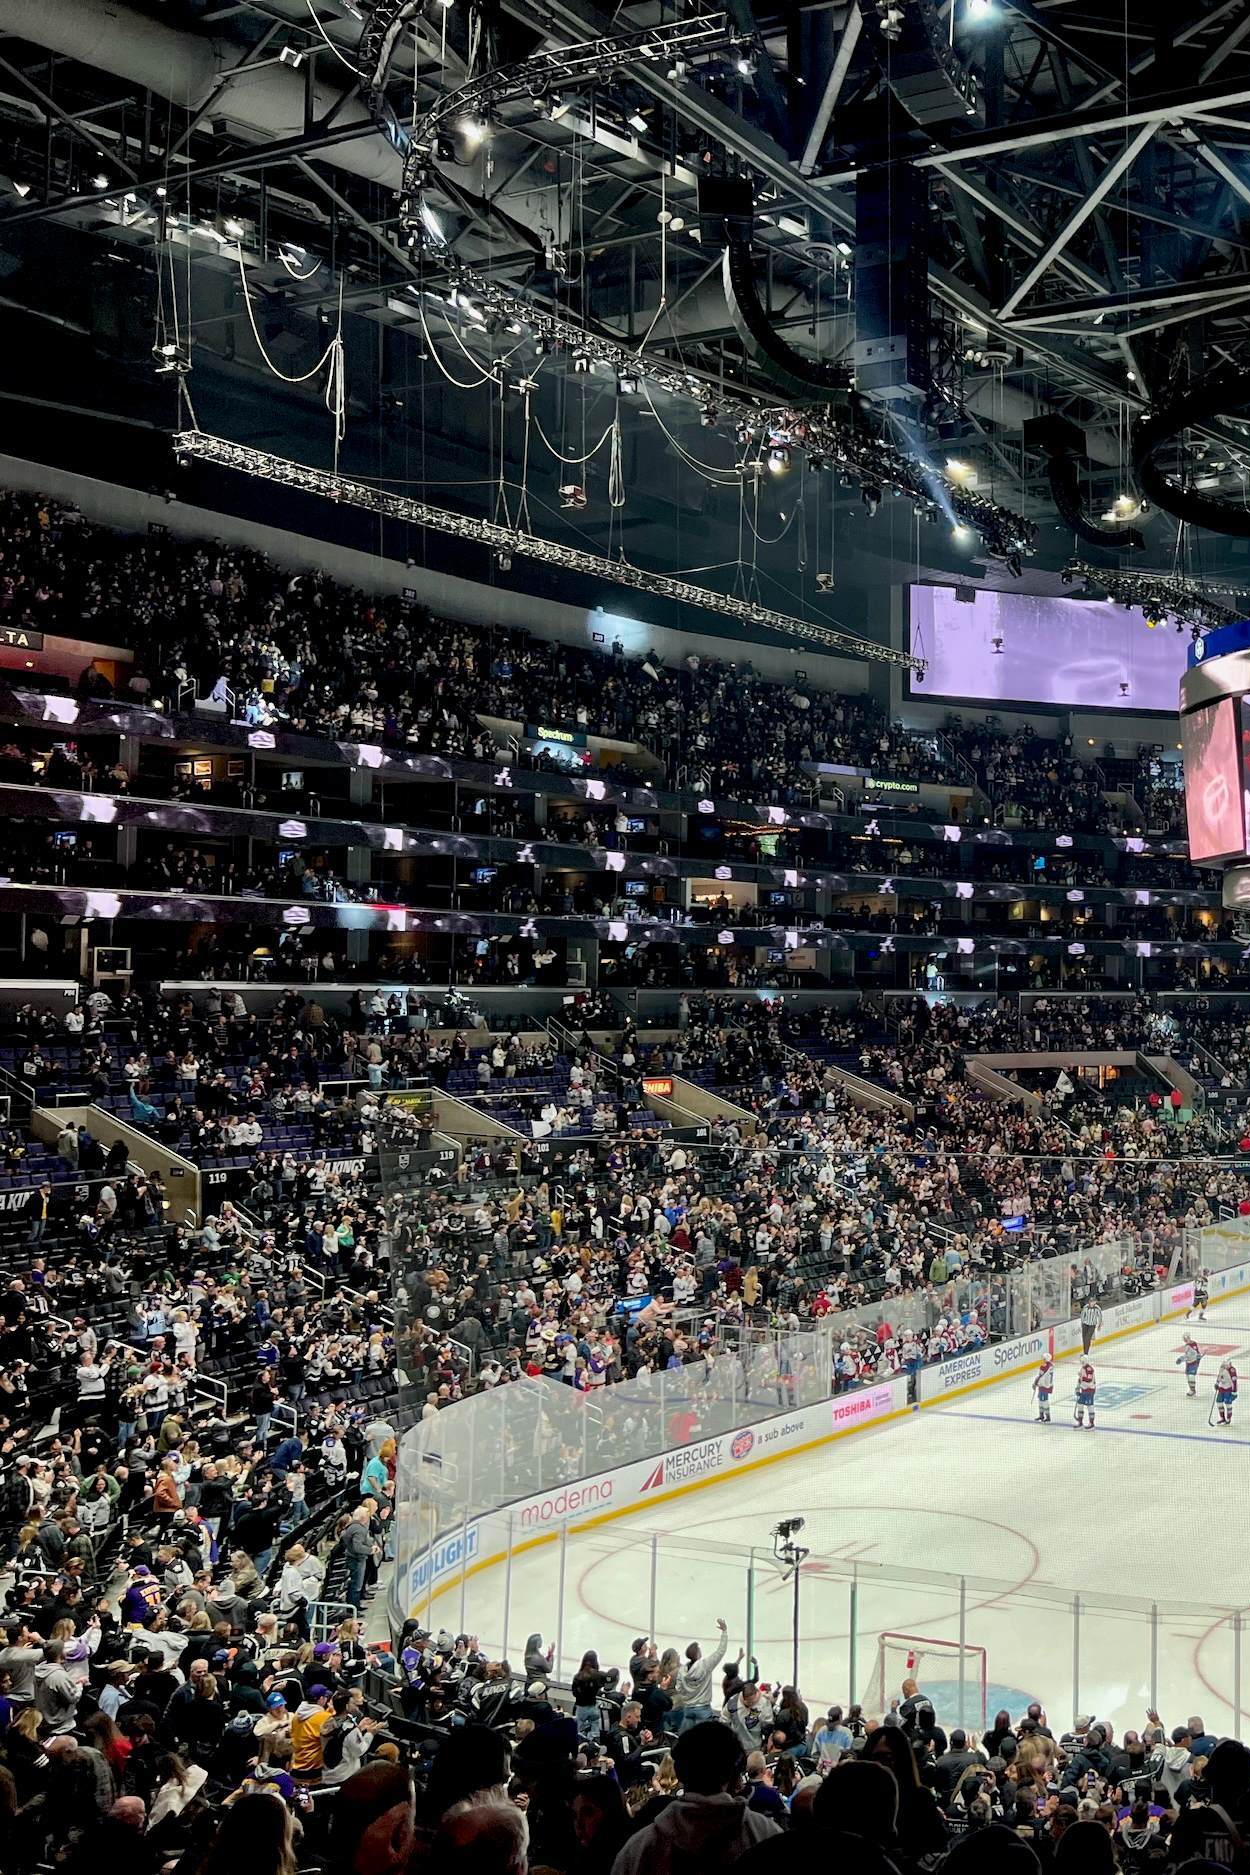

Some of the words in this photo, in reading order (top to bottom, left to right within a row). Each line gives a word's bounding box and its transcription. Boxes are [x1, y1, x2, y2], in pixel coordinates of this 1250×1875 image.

[0, 631, 29, 647] TA
[537, 727, 573, 742] Spectrum
[875, 779, 918, 792] crypto.com
[333, 1158, 367, 1173] KINGS
[208, 1172, 228, 1184] 119
[994, 1338, 1041, 1368] Spectrum
[939, 1353, 981, 1377] AMERICAN
[944, 1366, 981, 1388] EXPRESS
[832, 1399, 872, 1421] TOSHIBA
[763, 1428, 779, 1442] sub
[780, 1421, 805, 1437] above
[666, 1440, 723, 1471] MERCURY
[666, 1454, 724, 1485] INSURANCE
[521, 1480, 613, 1529] moderna
[434, 1530, 477, 1574] LIGHT
[412, 1555, 434, 1594] BUD
